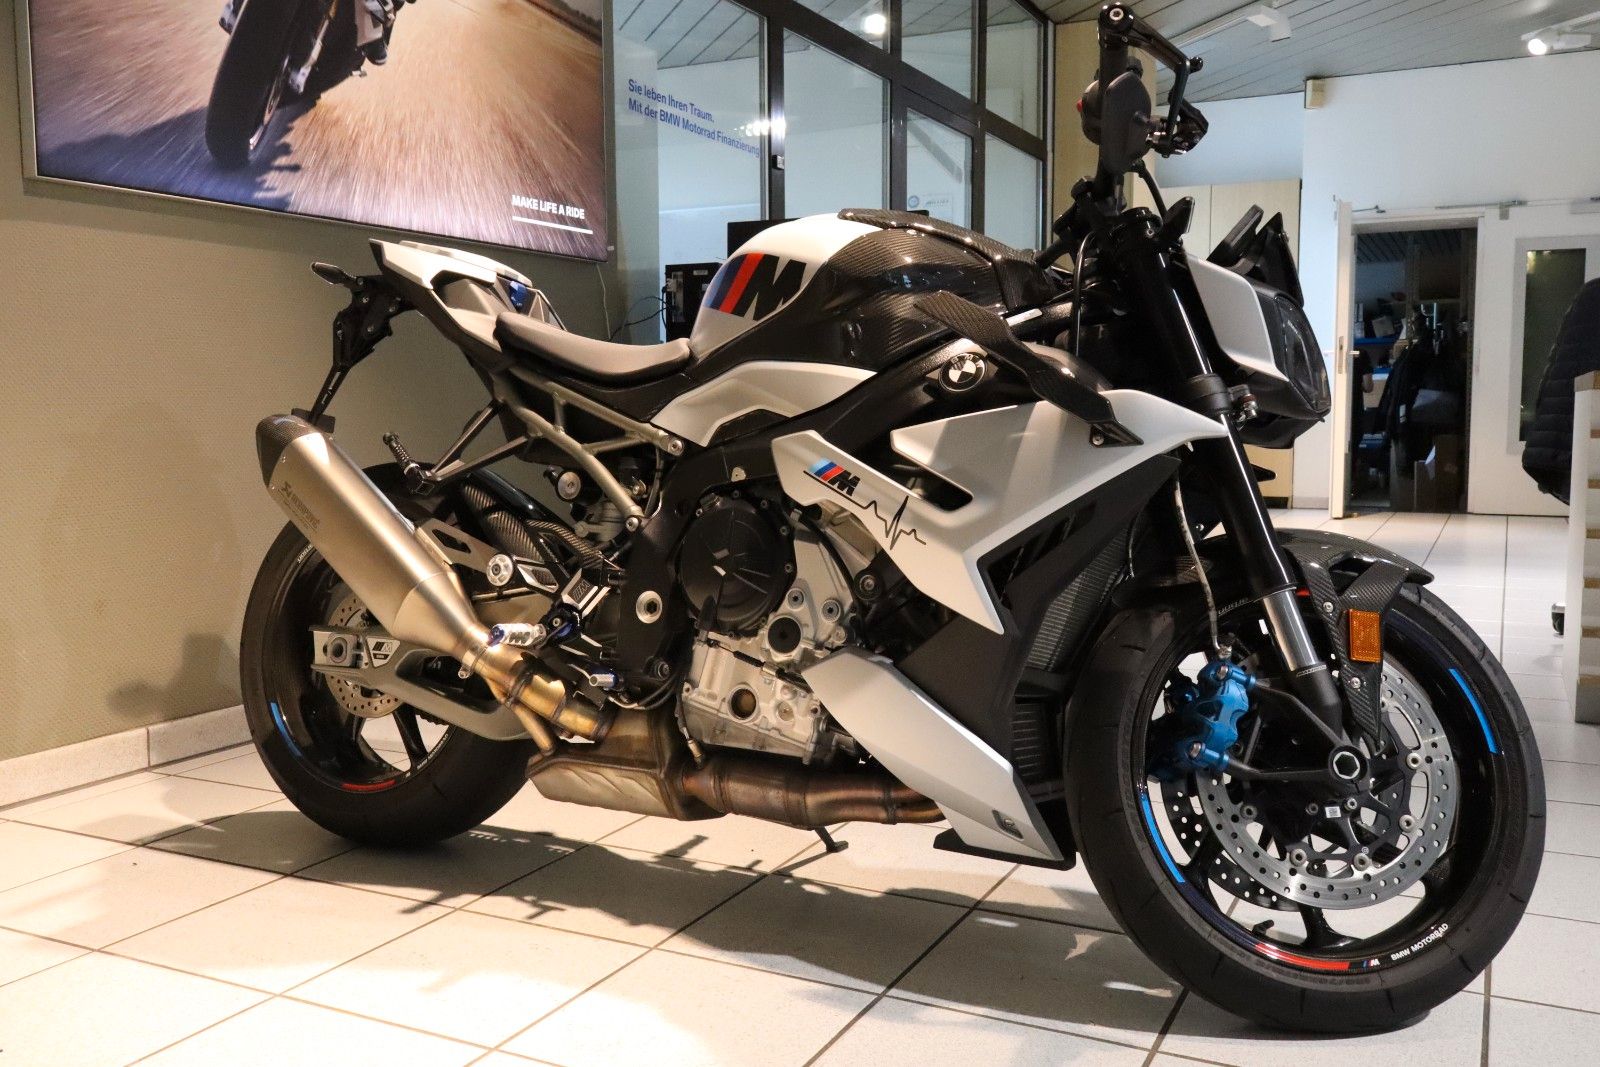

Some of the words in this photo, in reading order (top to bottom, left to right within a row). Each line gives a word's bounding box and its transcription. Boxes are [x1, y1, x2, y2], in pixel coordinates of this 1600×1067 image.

[628, 79, 643, 96] Sie
[644, 83, 667, 104] leben
[668, 94, 688, 112] Ihren
[689, 103, 714, 123] Traum.
[628, 97, 644, 115] Mit
[645, 103, 658, 120] der
[659, 109, 681, 128] BMW
[682, 118, 716, 140] Motorrad
[717, 131, 760, 158] Finanzierung
[511, 194, 539, 211] MAKE
[539, 199, 557, 214] LIFE
[557, 204, 566, 215] A
[566, 204, 585, 220] RIDE
[731, 253, 807, 322] M
[1391, 948, 1411, 961] BMW
[1410, 922, 1449, 952] MOTORRAD
